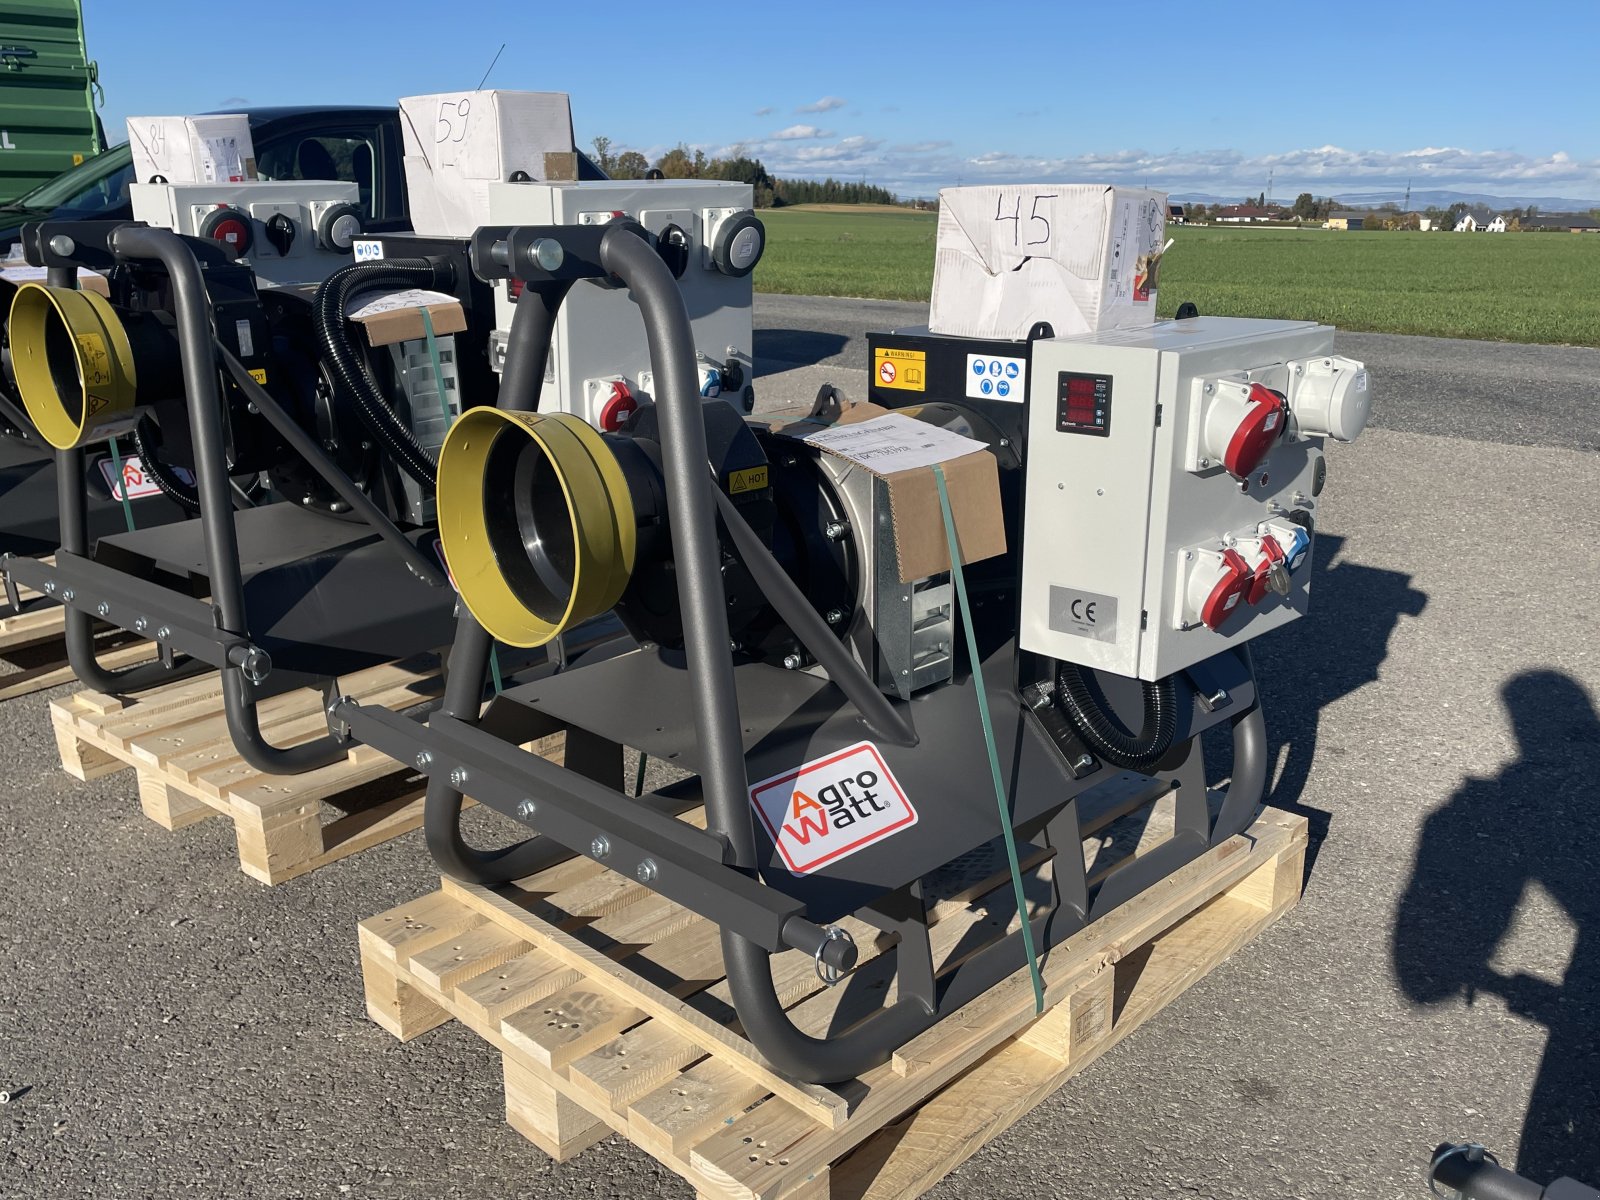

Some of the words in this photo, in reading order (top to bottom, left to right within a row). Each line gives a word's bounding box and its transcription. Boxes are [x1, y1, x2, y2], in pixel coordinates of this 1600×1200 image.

[150, 124, 166, 156] 84
[436, 98, 471, 144] 59
[995, 193, 1058, 246] 45
[748, 472, 766, 484] HOT
[1071, 598, 1097, 624] CE
[792, 770, 878, 818] Agro
